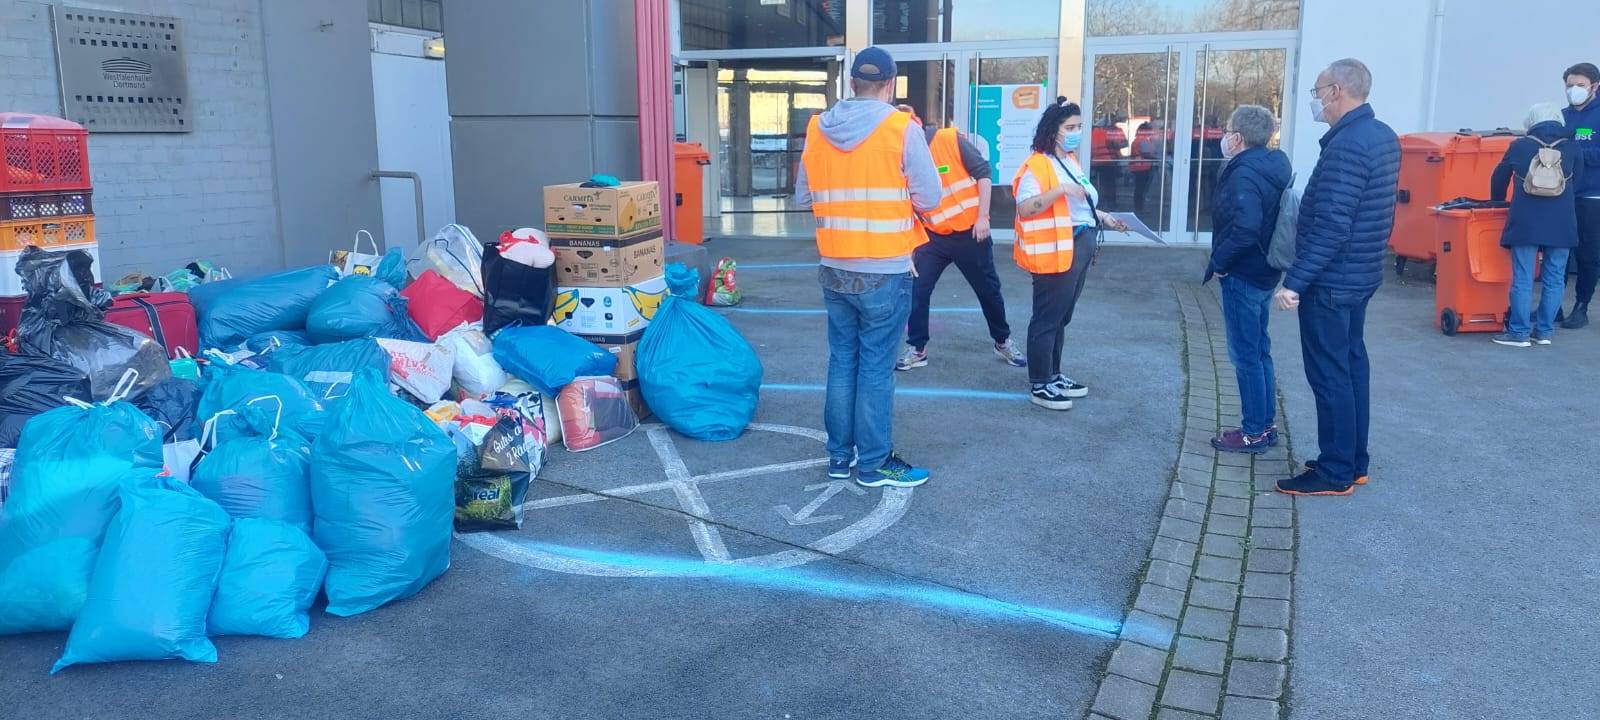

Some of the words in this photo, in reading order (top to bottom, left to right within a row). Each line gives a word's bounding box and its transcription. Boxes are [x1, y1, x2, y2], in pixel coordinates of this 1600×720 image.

[633, 246, 656, 259] BANANAS
[493, 432, 514, 453] Gutes
[473, 488, 499, 500] real
